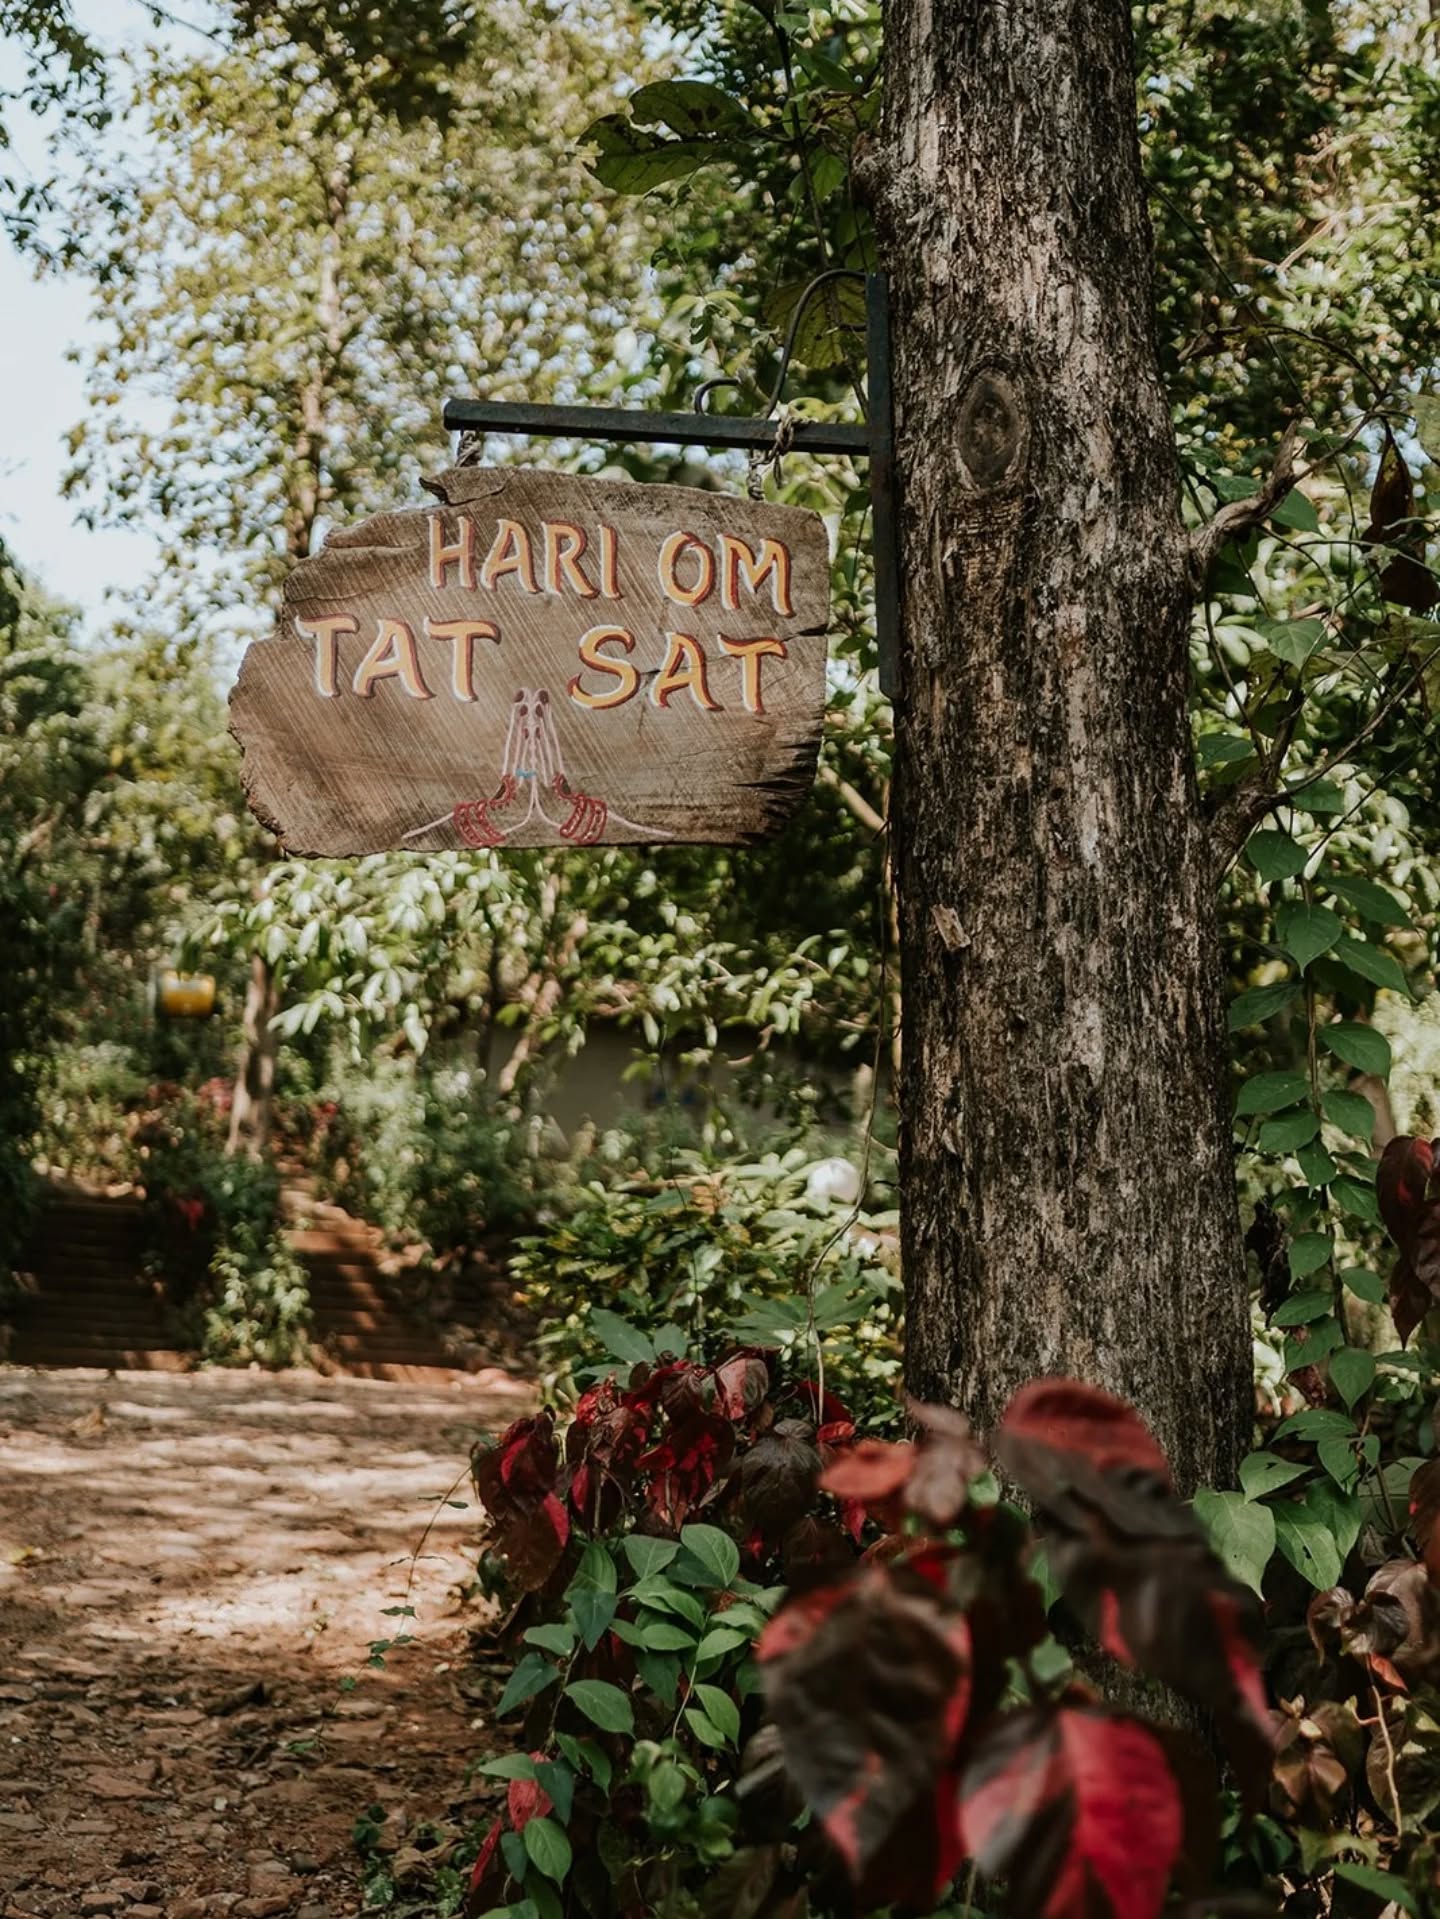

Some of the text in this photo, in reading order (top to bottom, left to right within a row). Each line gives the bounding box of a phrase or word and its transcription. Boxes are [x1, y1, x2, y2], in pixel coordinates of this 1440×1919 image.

[427, 515, 796, 618] HARI OM
[295, 613, 788, 715] TAT SAT
